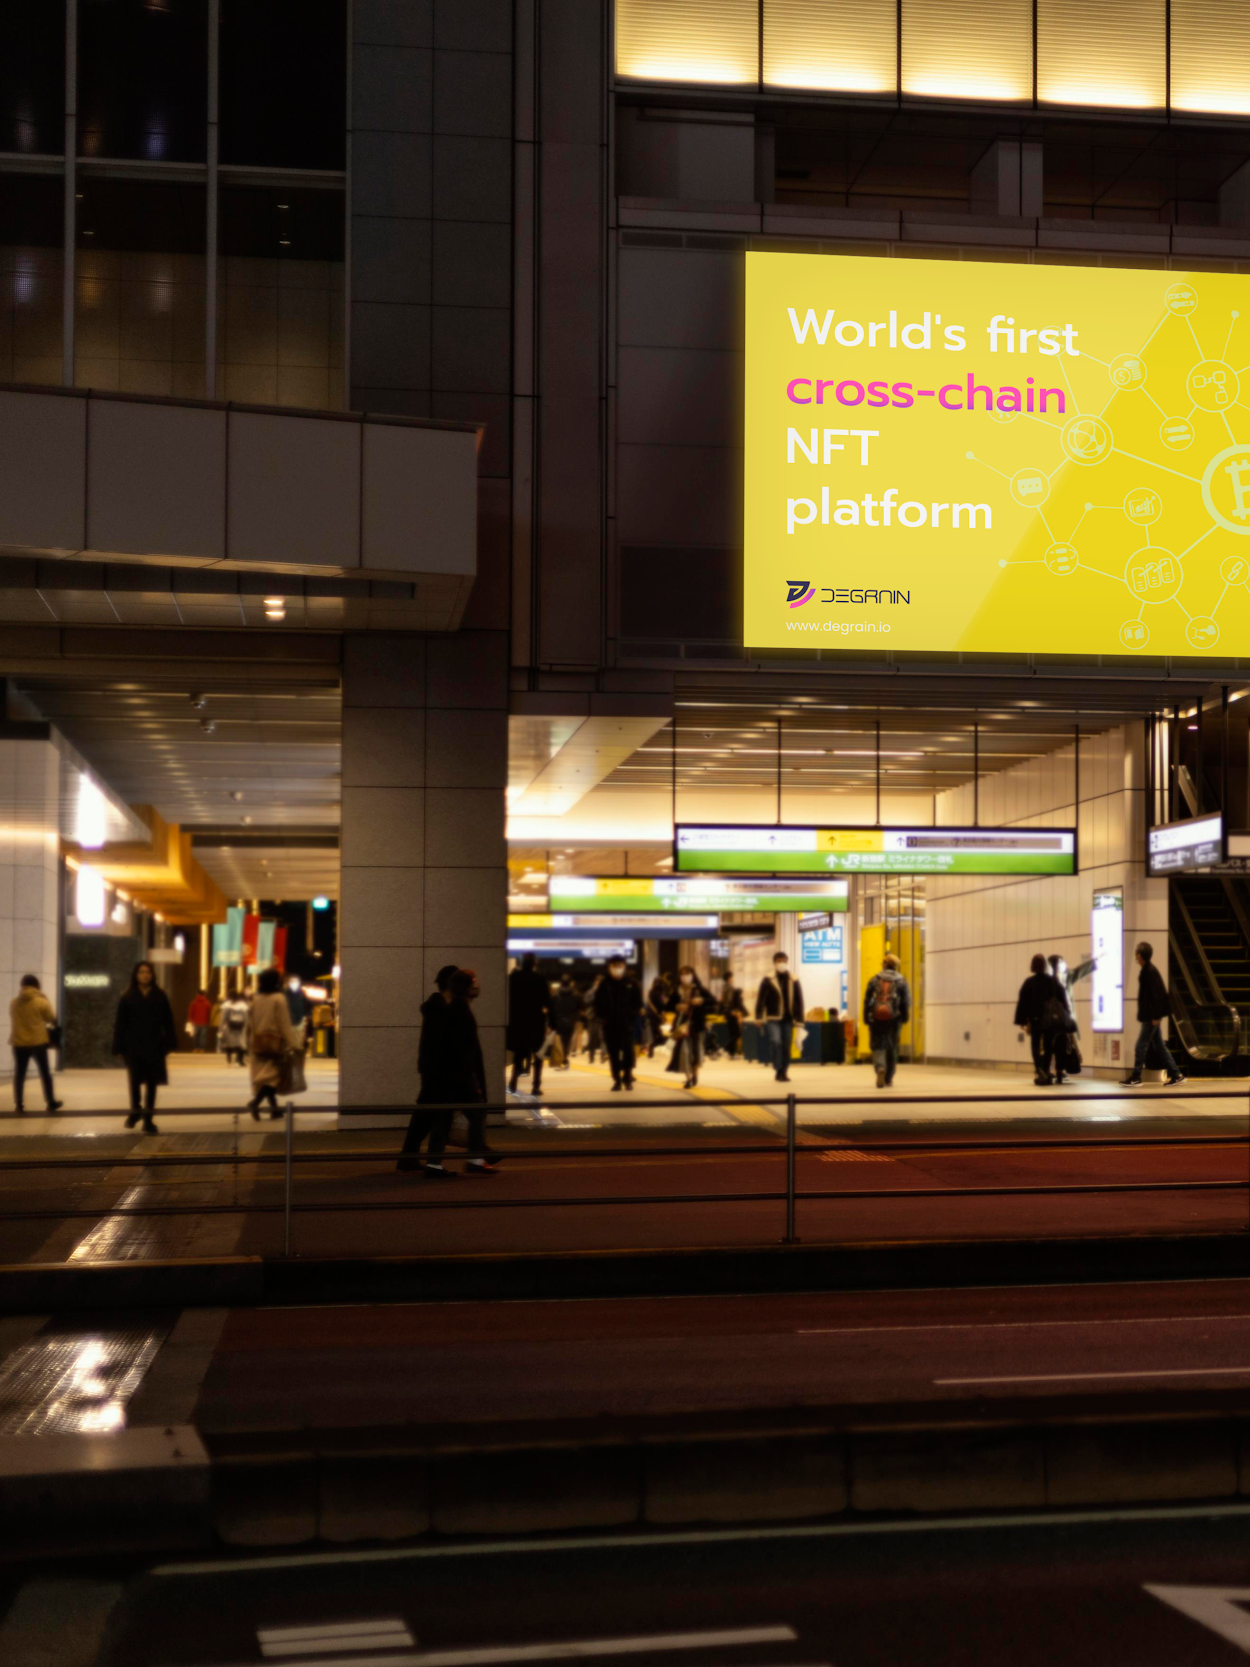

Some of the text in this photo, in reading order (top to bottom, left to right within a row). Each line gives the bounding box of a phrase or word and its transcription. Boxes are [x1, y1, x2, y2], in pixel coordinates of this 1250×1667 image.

[787, 307, 1080, 356] World's first
[786, 373, 1066, 414] cross-chain
[787, 427, 880, 466] NFT
[787, 486, 992, 535] platform
[785, 620, 892, 635] www.degrain.io
